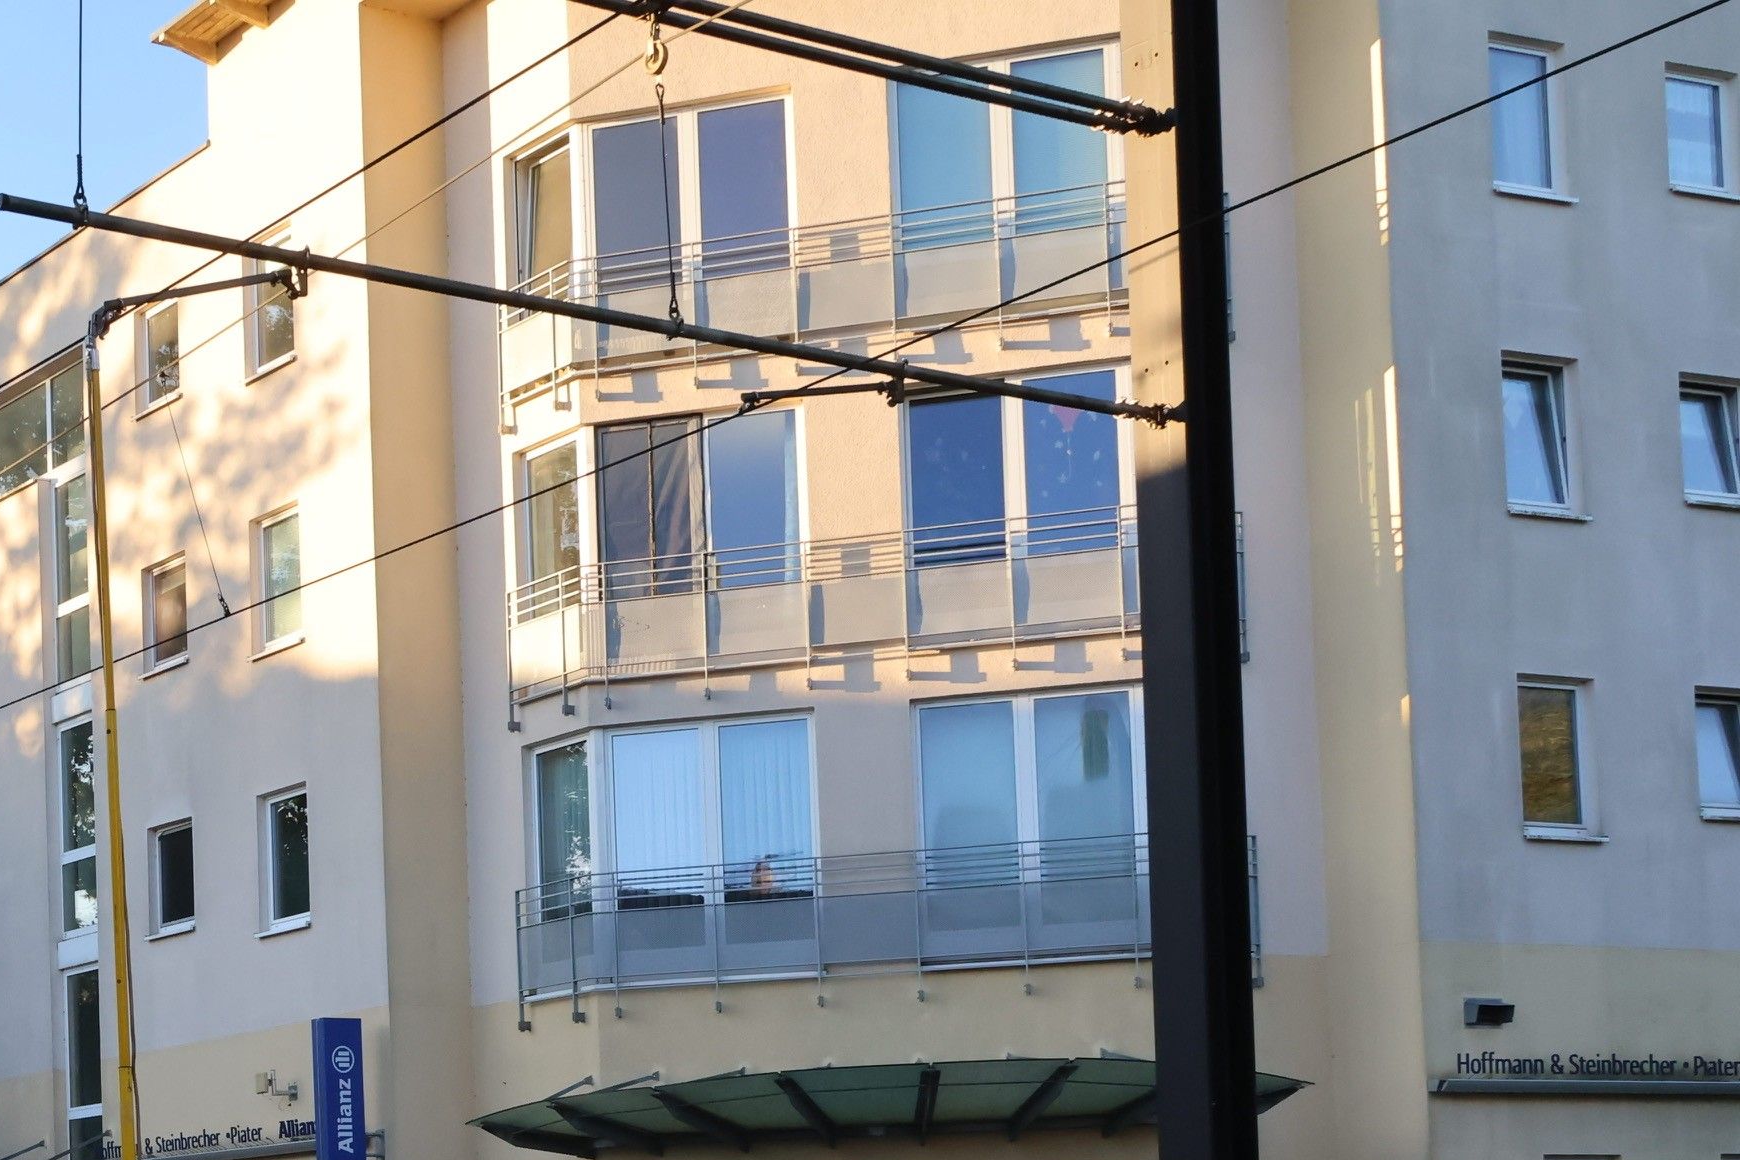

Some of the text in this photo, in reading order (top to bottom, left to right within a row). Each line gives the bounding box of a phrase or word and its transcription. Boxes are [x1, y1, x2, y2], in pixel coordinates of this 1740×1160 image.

[1456, 1051, 1545, 1076] Hoffmann
[1550, 1053, 1564, 1076] &
[1568, 1054, 1677, 1077] Steinbrecher
[337, 1078, 354, 1154] Allianz
[144, 1137, 153, 1155] &
[155, 1128, 221, 1154] Steinbrecher
[278, 1119, 316, 1139] Allian
